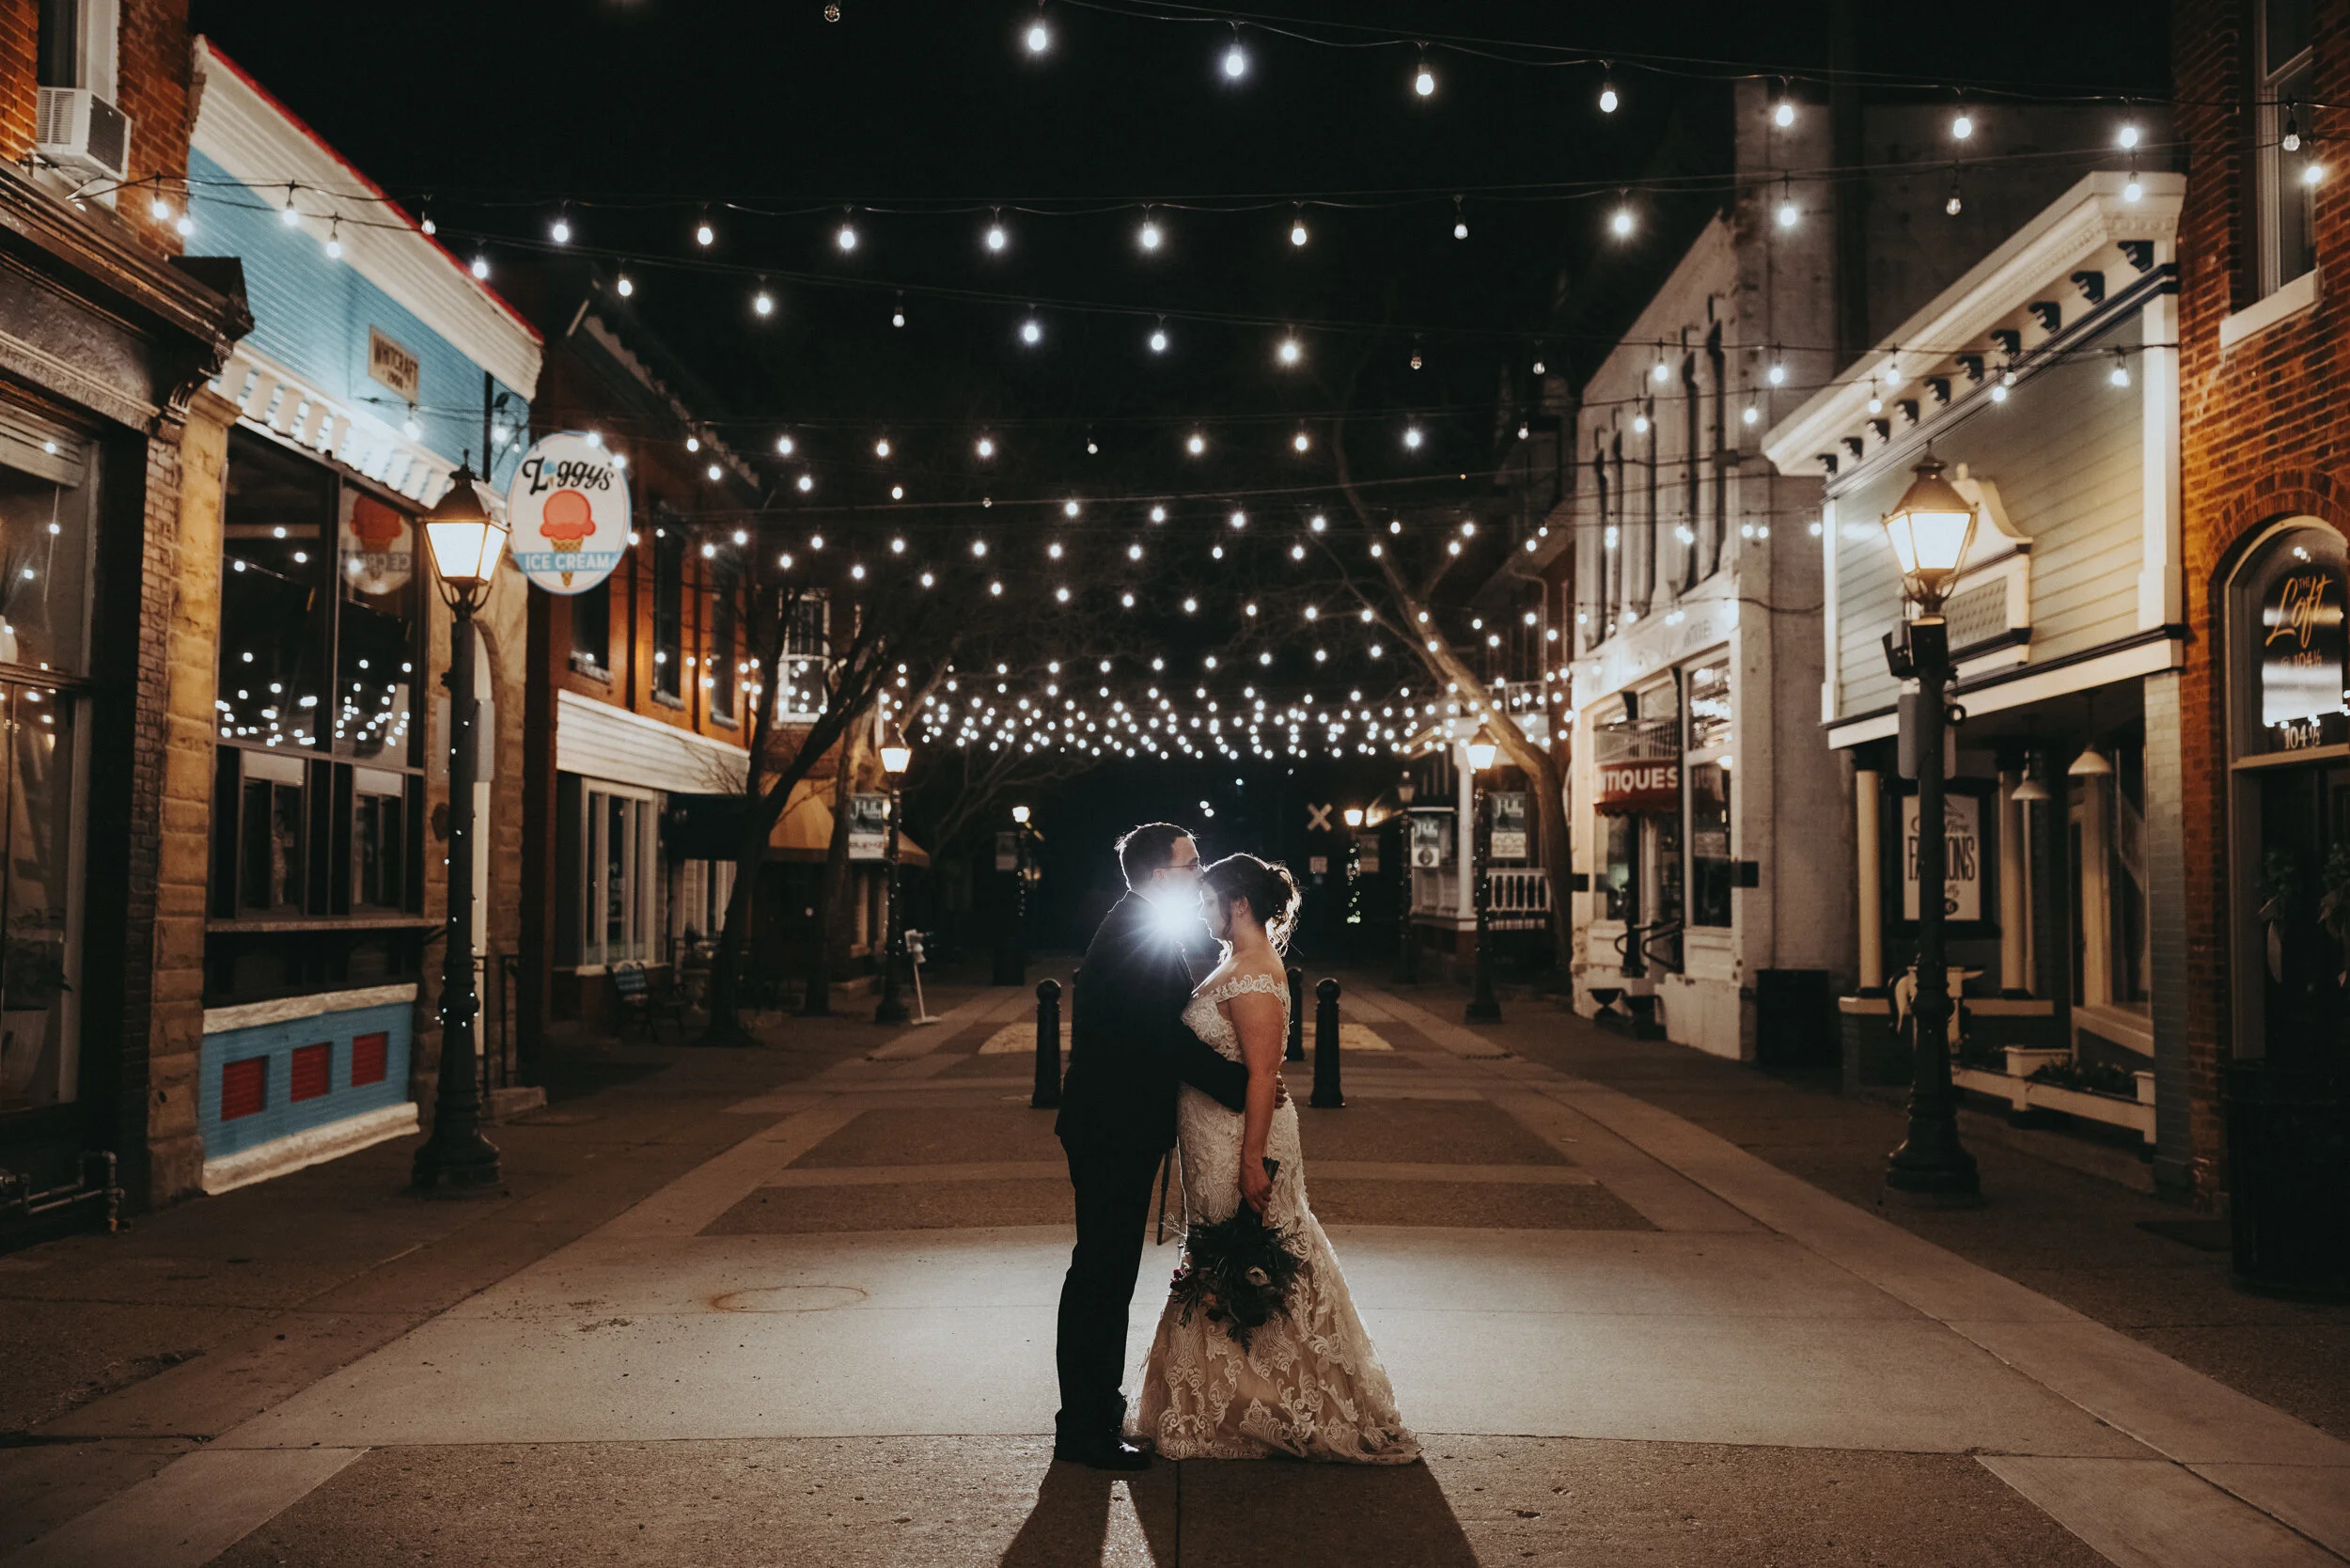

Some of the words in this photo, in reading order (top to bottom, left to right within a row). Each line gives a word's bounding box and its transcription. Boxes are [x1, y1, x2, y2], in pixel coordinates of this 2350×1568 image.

[525, 554, 550, 570] ICE
[555, 554, 610, 570] CREAM
[2299, 575, 2311, 589] THE
[2265, 573, 2334, 649] Loft
[1600, 766, 1678, 793] TIQUES
